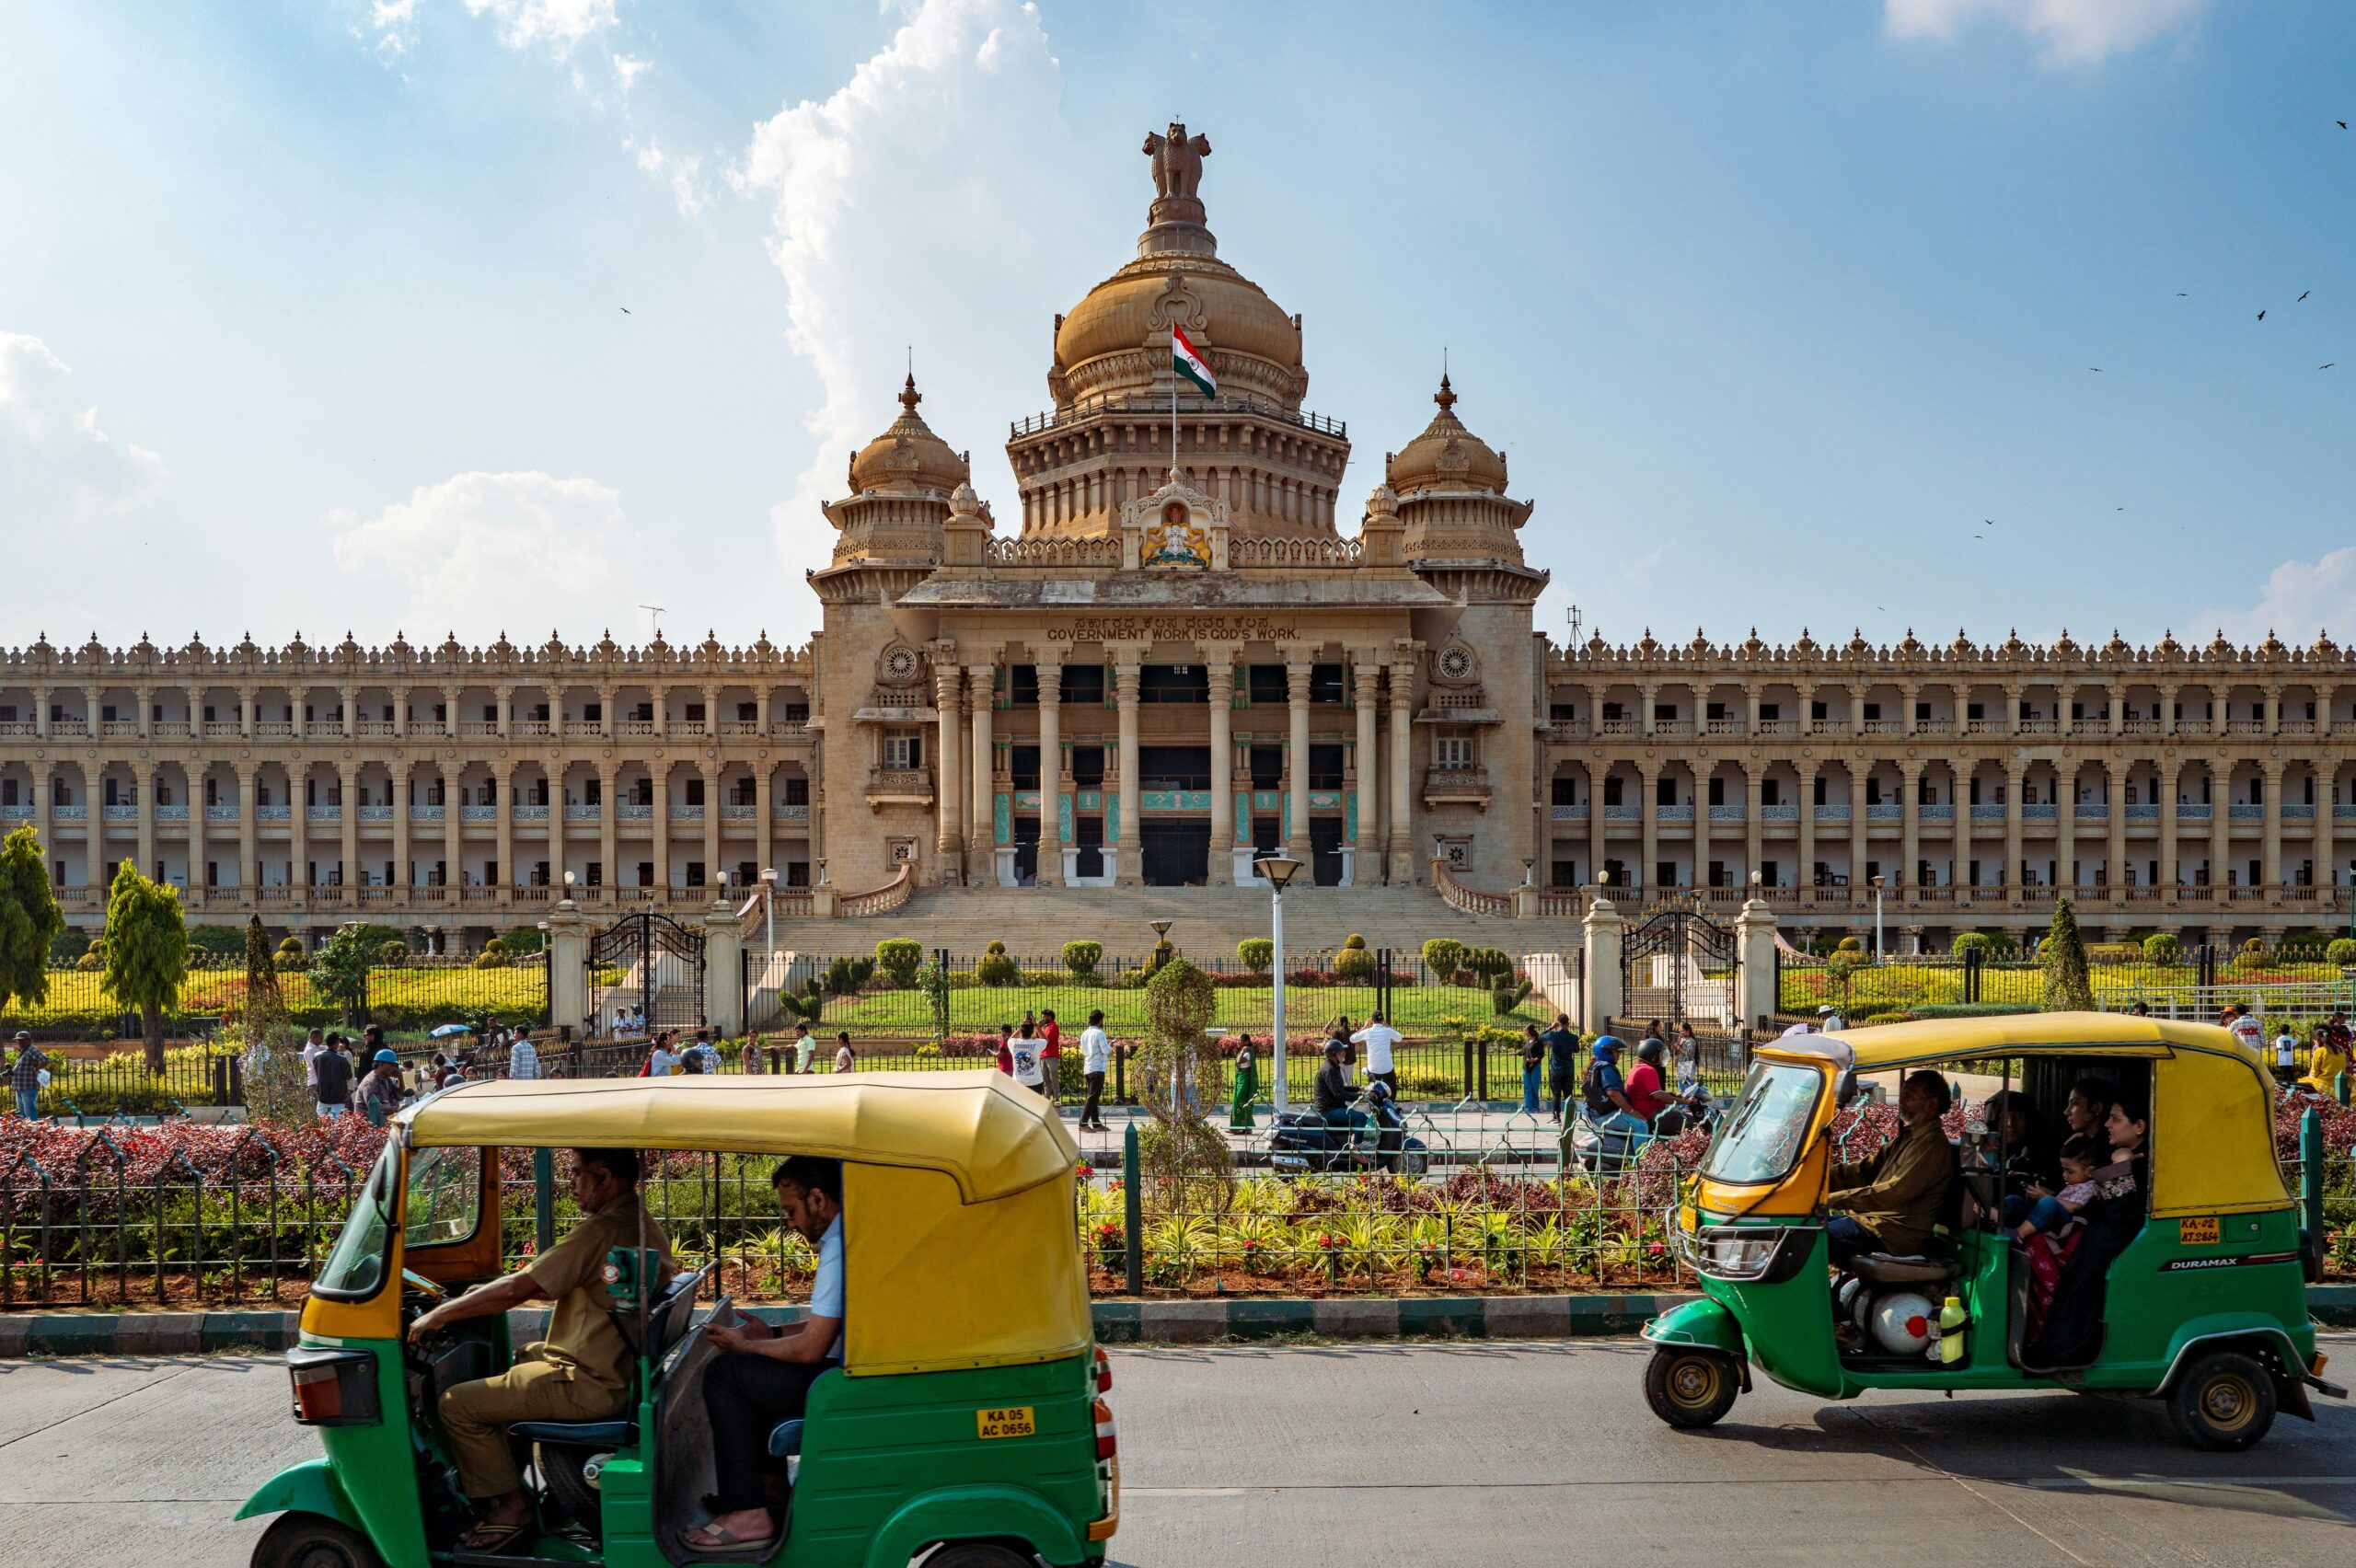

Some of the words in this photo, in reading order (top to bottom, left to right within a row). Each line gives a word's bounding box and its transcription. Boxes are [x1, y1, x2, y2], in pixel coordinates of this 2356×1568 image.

[1074, 617, 1136, 628] ಸರ್ಕಾರದ
[1142, 617, 1178, 628] ಕೆಲಸ
[1185, 617, 1226, 628] ದೇವರ
[1047, 628, 1147, 640] GOVERNMENT
[1152, 628, 1191, 640] WORK
[1194, 628, 1207, 640] IS
[1210, 628, 1251, 640] GOD'S
[1256, 628, 1301, 640] WORK.
[2171, 1258, 2238, 1270] DURAMAX
[987, 1411, 1006, 1422] KA
[1009, 1409, 1024, 1421] 05
[982, 1424, 999, 1436] AC
[1002, 1423, 1032, 1435] 0656
